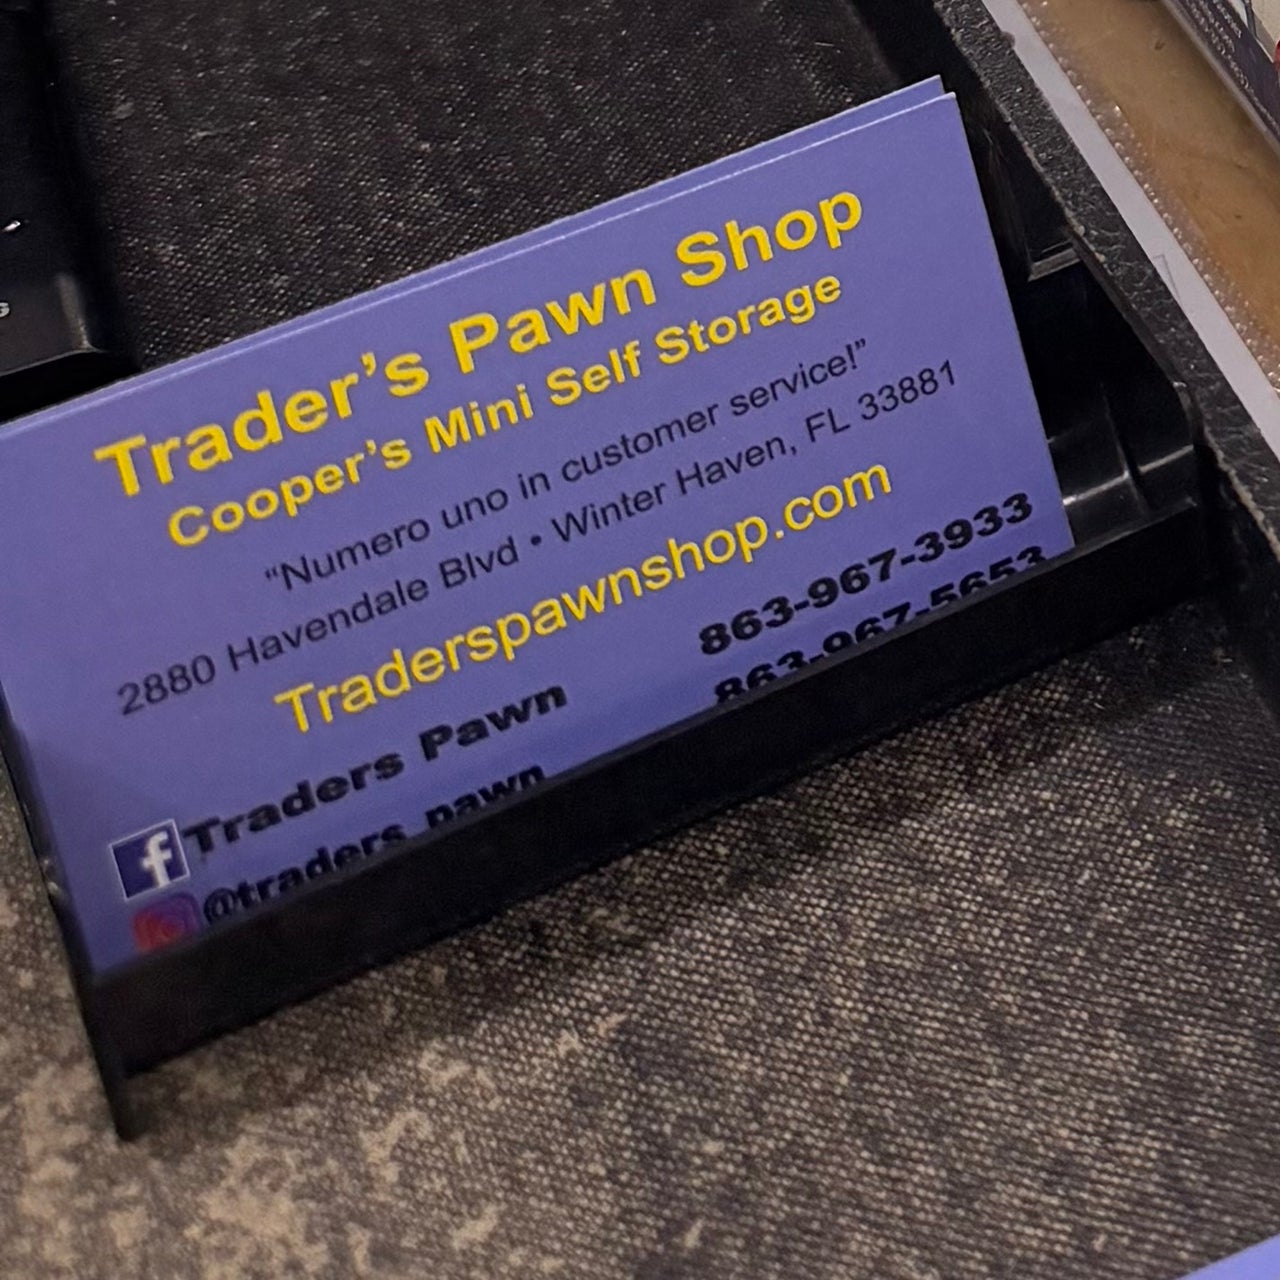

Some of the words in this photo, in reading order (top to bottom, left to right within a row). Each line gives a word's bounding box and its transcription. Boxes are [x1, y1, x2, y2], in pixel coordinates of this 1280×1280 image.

[94, 351, 430, 497] Trader’s
[448, 268, 657, 375] Pawn
[675, 191, 863, 287] Shop
[168, 438, 412, 548] Cooper’s
[423, 383, 534, 454] Mini
[546, 340, 641, 407] Self
[655, 275, 842, 365] Storage
[117, 654, 217, 716] 2880
[226, 576, 431, 672] Havendale
[438, 538, 520, 590] Blvd
[551, 481, 668, 544] Winter
[675, 435, 798, 496] Haven,
[804, 406, 851, 444] FL
[857, 359, 957, 422] 33881
[264, 518, 431, 590] “Numero
[440, 488, 509, 529] uno
[517, 470, 551, 499] in
[560, 403, 720, 483] customer
[273, 463, 893, 733] Traderspawnshop.com
[698, 492, 1034, 656] 863-967-3933
[182, 752, 405, 856] Traders
[418, 684, 568, 762] Pawn
